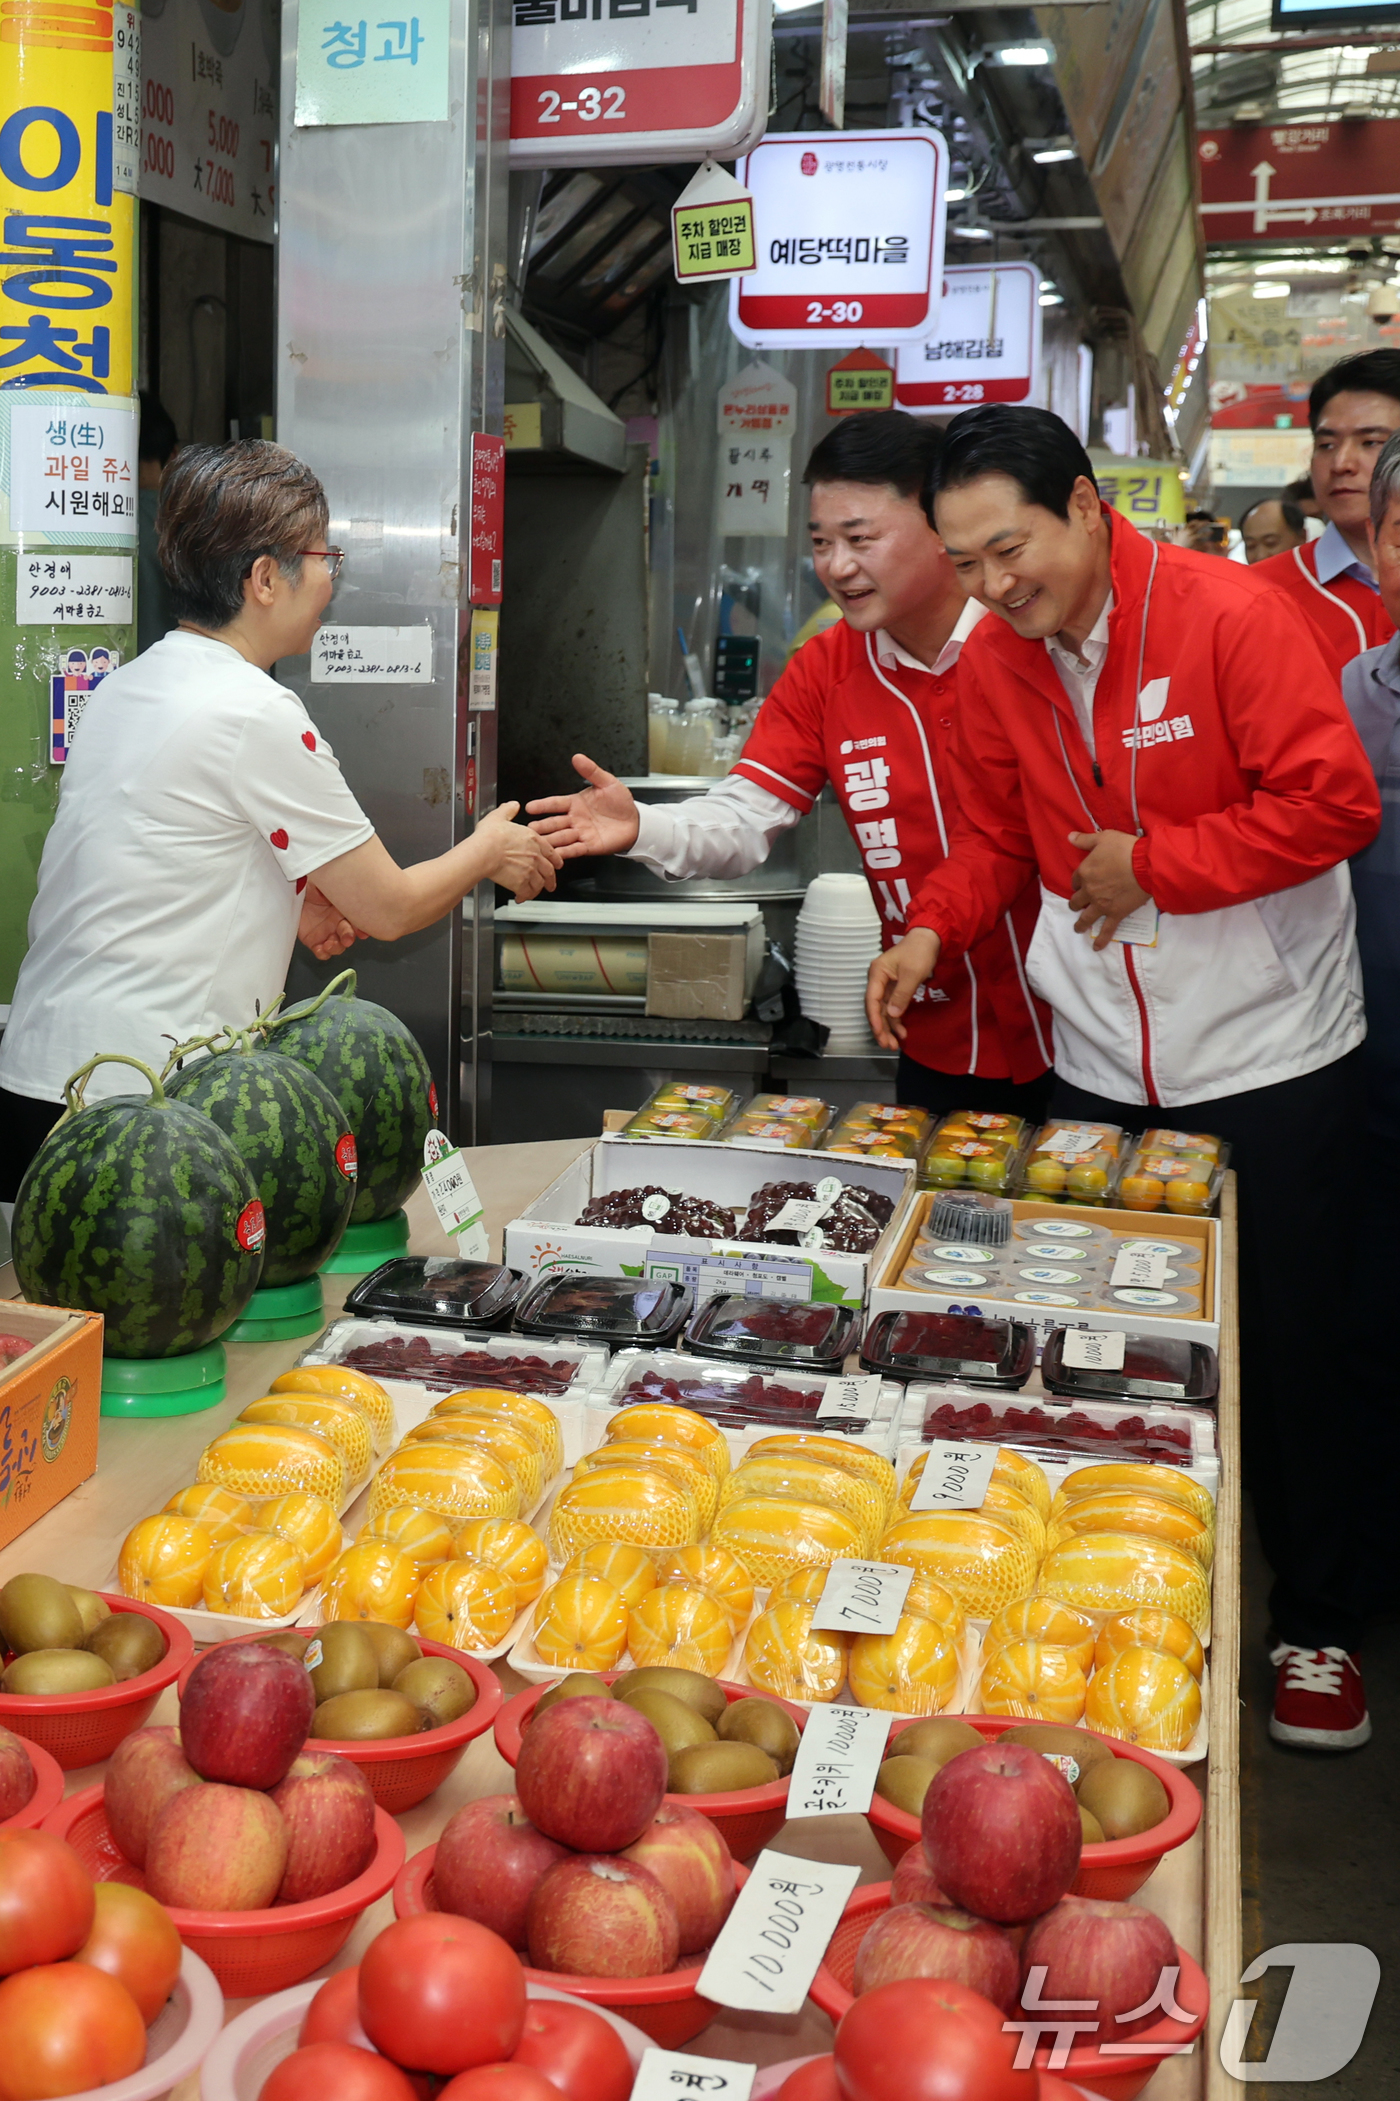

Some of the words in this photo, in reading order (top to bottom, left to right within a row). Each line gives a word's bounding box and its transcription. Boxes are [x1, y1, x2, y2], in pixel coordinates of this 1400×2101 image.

[321, 17, 425, 70] 청과
[537, 86, 627, 124] 2-32
[208, 109, 240, 159] 5,000
[823, 159, 889, 172] 광명전통시장
[206, 159, 235, 207] 7,000
[681, 222, 704, 239] 주차
[708, 215, 747, 236] 할인권
[688, 240, 712, 261] 지급
[716, 237, 742, 257] 매장
[770, 236, 910, 265] 예당떡마을
[806, 301, 864, 324] 2-30
[943, 383, 985, 402] 2-28
[45, 419, 105, 450] 생(生)
[44, 455, 90, 482] 과일
[101, 458, 132, 482] 쥬스
[45, 488, 135, 518] 시원해요!!!
[853, 735, 887, 750] 국민의힘
[1122, 714, 1195, 749] 국민의힘
[561, 1253, 593, 1261] HAESALNURI
[656, 1271, 673, 1280] GAP
[804, 1763, 854, 1811] 골드키위
